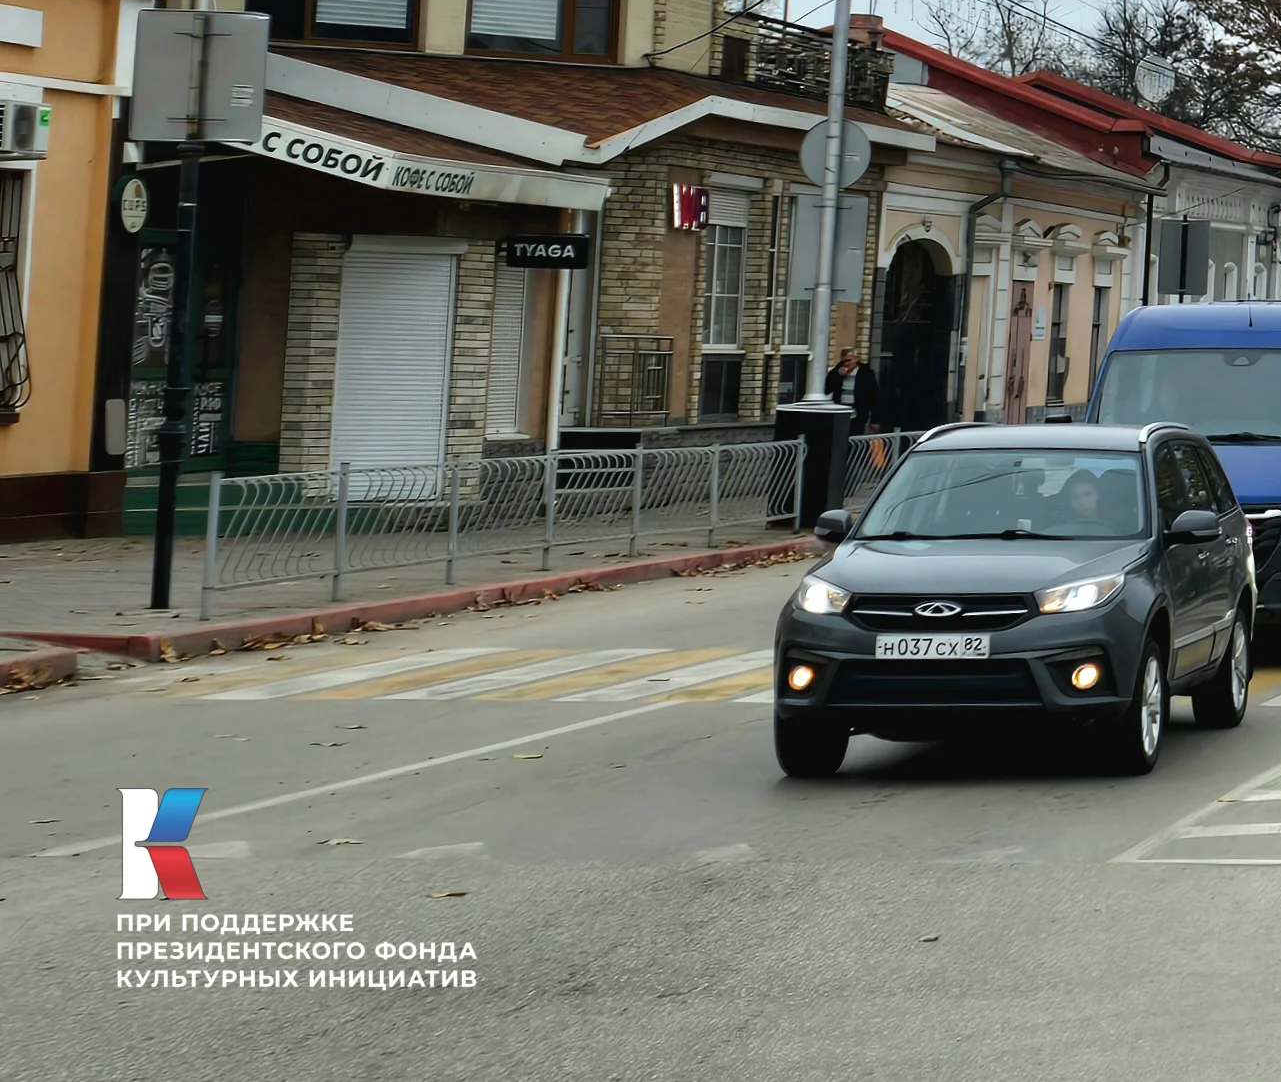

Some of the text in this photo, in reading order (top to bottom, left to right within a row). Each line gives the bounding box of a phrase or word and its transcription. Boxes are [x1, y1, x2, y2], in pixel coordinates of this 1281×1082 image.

[286, 137, 386, 182] СОБОЙ
[392, 166, 427, 189] КОФЕ
[435, 171, 476, 195] СОБОЙ
[514, 243, 576, 258] TYAGA
